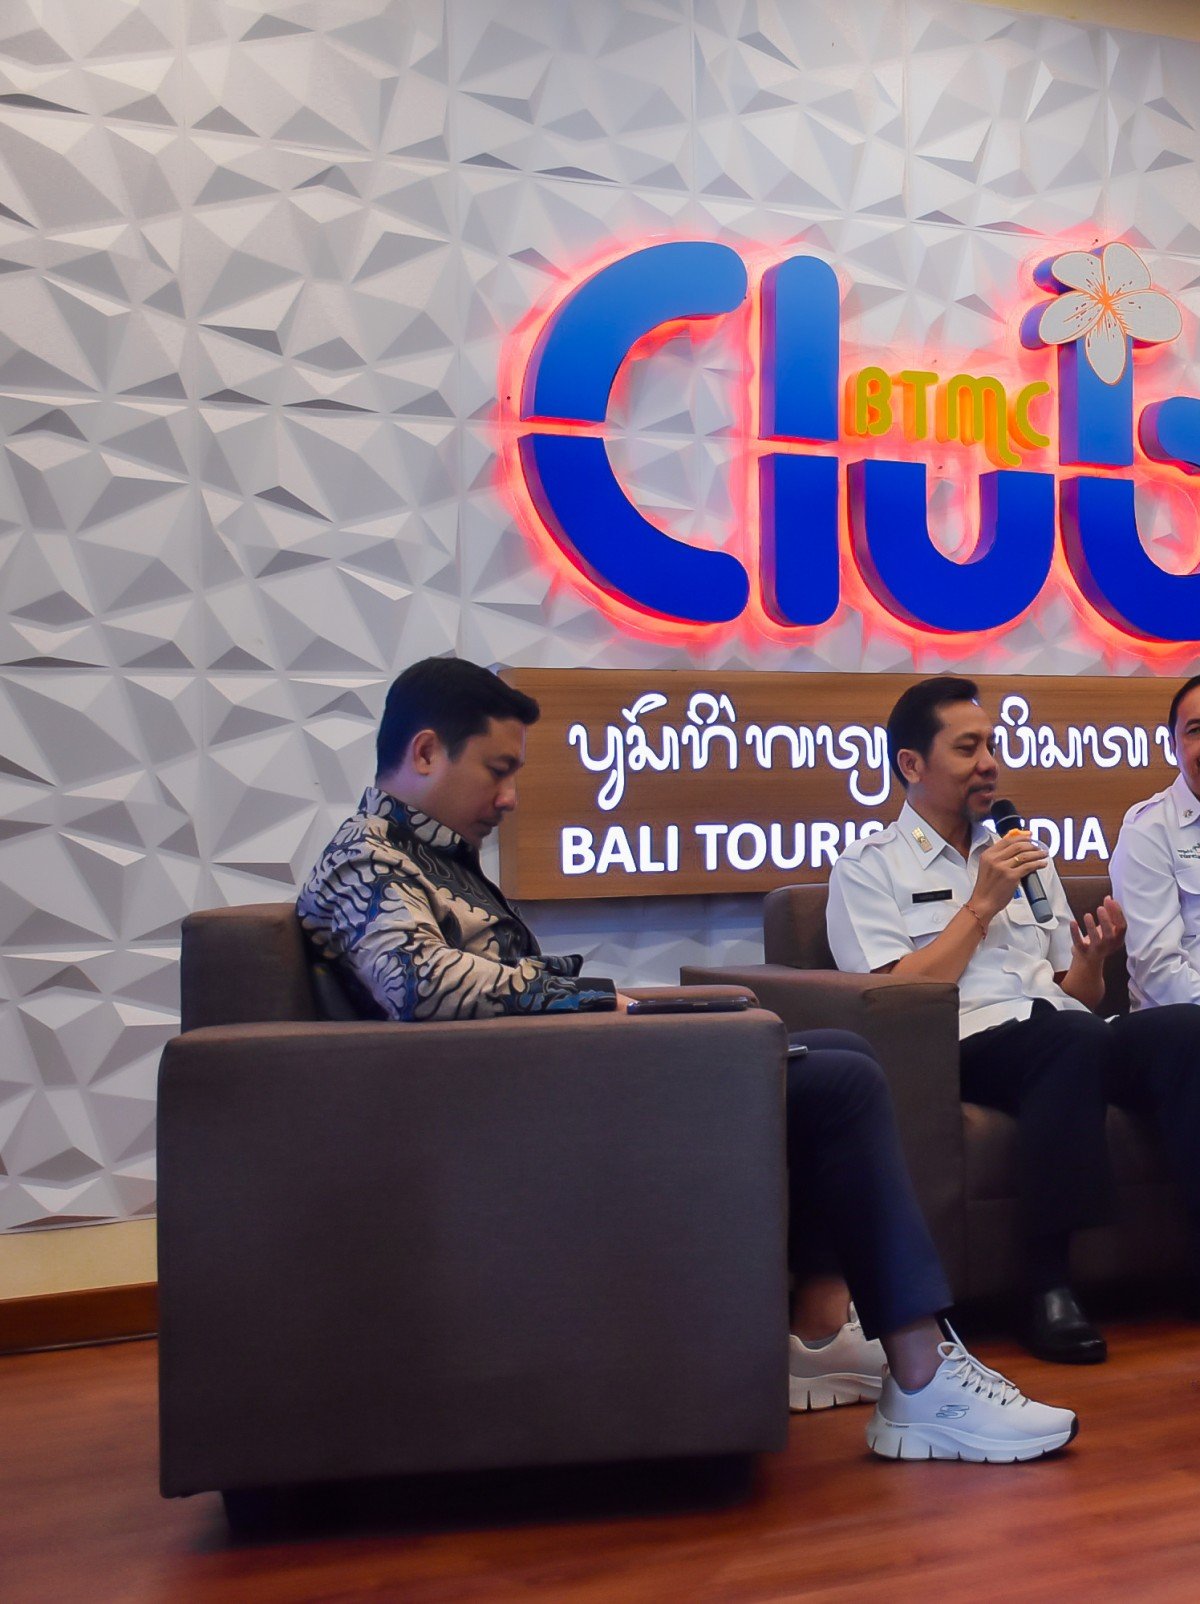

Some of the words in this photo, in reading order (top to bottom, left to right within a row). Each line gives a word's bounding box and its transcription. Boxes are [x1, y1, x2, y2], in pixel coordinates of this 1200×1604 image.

[847, 366, 1050, 467] BTMC
[562, 825, 679, 875] BALI
[982, 816, 1110, 861] DIA
